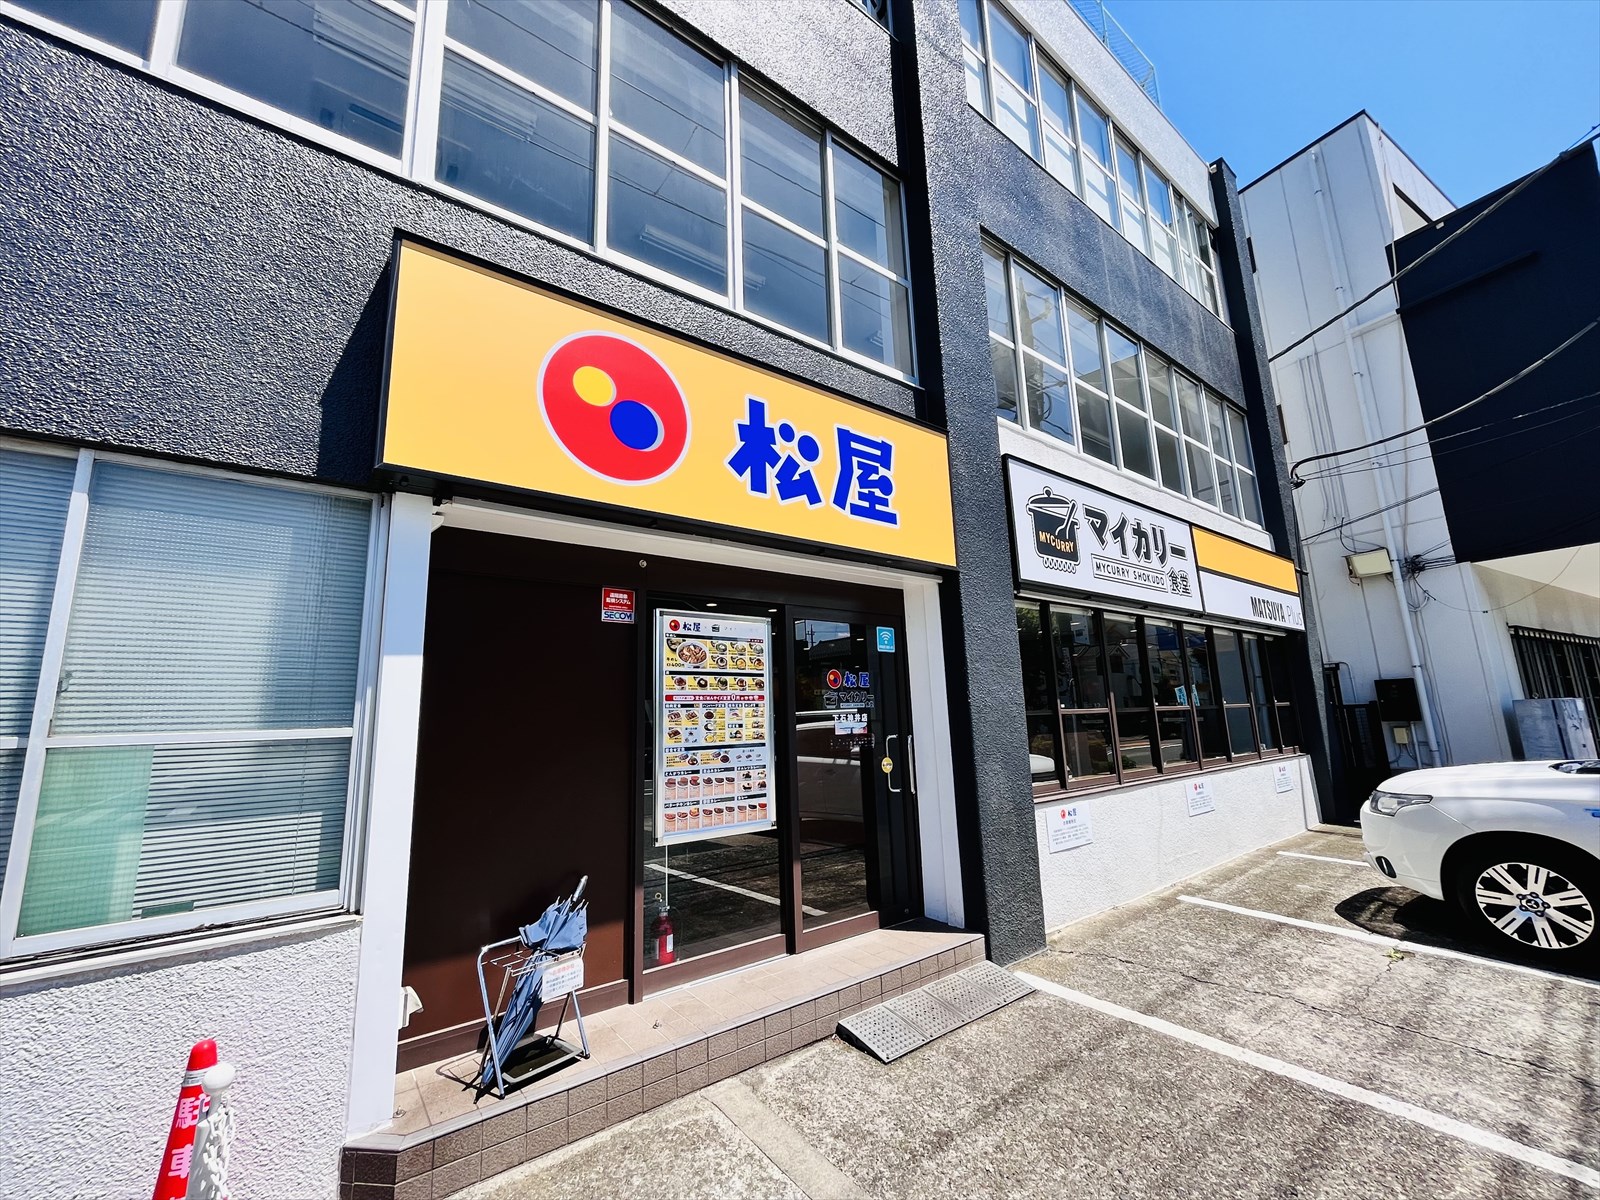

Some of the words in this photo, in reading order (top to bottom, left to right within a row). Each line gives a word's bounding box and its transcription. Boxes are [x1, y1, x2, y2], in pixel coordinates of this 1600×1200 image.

[725, 395, 899, 528] 松屋
[1039, 530, 1075, 554] MYCURRY
[1082, 503, 1188, 568] マイカリー
[1095, 561, 1130, 580] MYCURRY
[1133, 570, 1165, 586] SHOKUDO
[1167, 567, 1192, 597] 食堂
[603, 611, 633, 621] SECOM
[1250, 596, 1286, 622] MATSUYA
[1286, 604, 1303, 626] Plus
[682, 621, 701, 632] 松屋
[843, 670, 870, 688] 松屋
